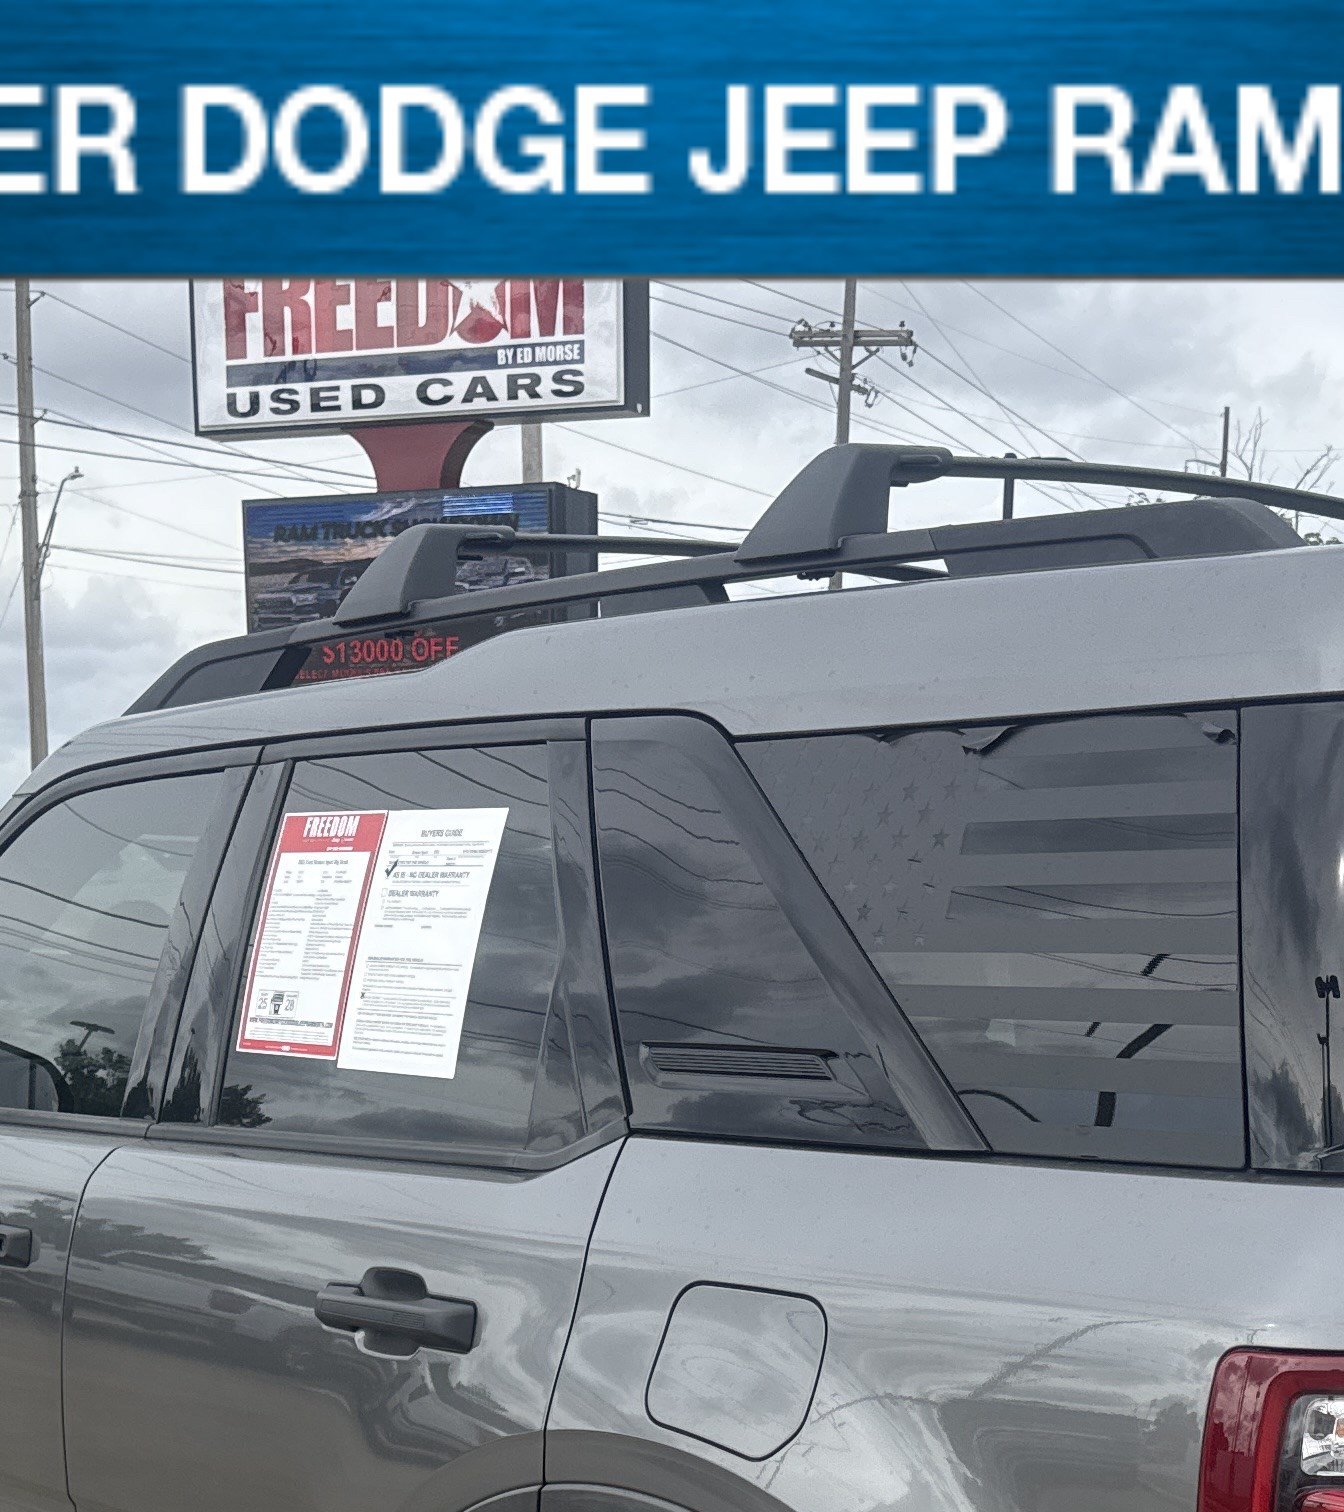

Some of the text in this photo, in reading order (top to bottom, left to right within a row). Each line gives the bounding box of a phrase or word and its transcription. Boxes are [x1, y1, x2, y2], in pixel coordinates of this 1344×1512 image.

[222, 279, 586, 361] FREEDOM
[496, 342, 581, 366] BY ED MORSE
[226, 369, 586, 419] USED CARS
[411, 635, 460, 663] OFF
[302, 815, 361, 838] FREEDOM
